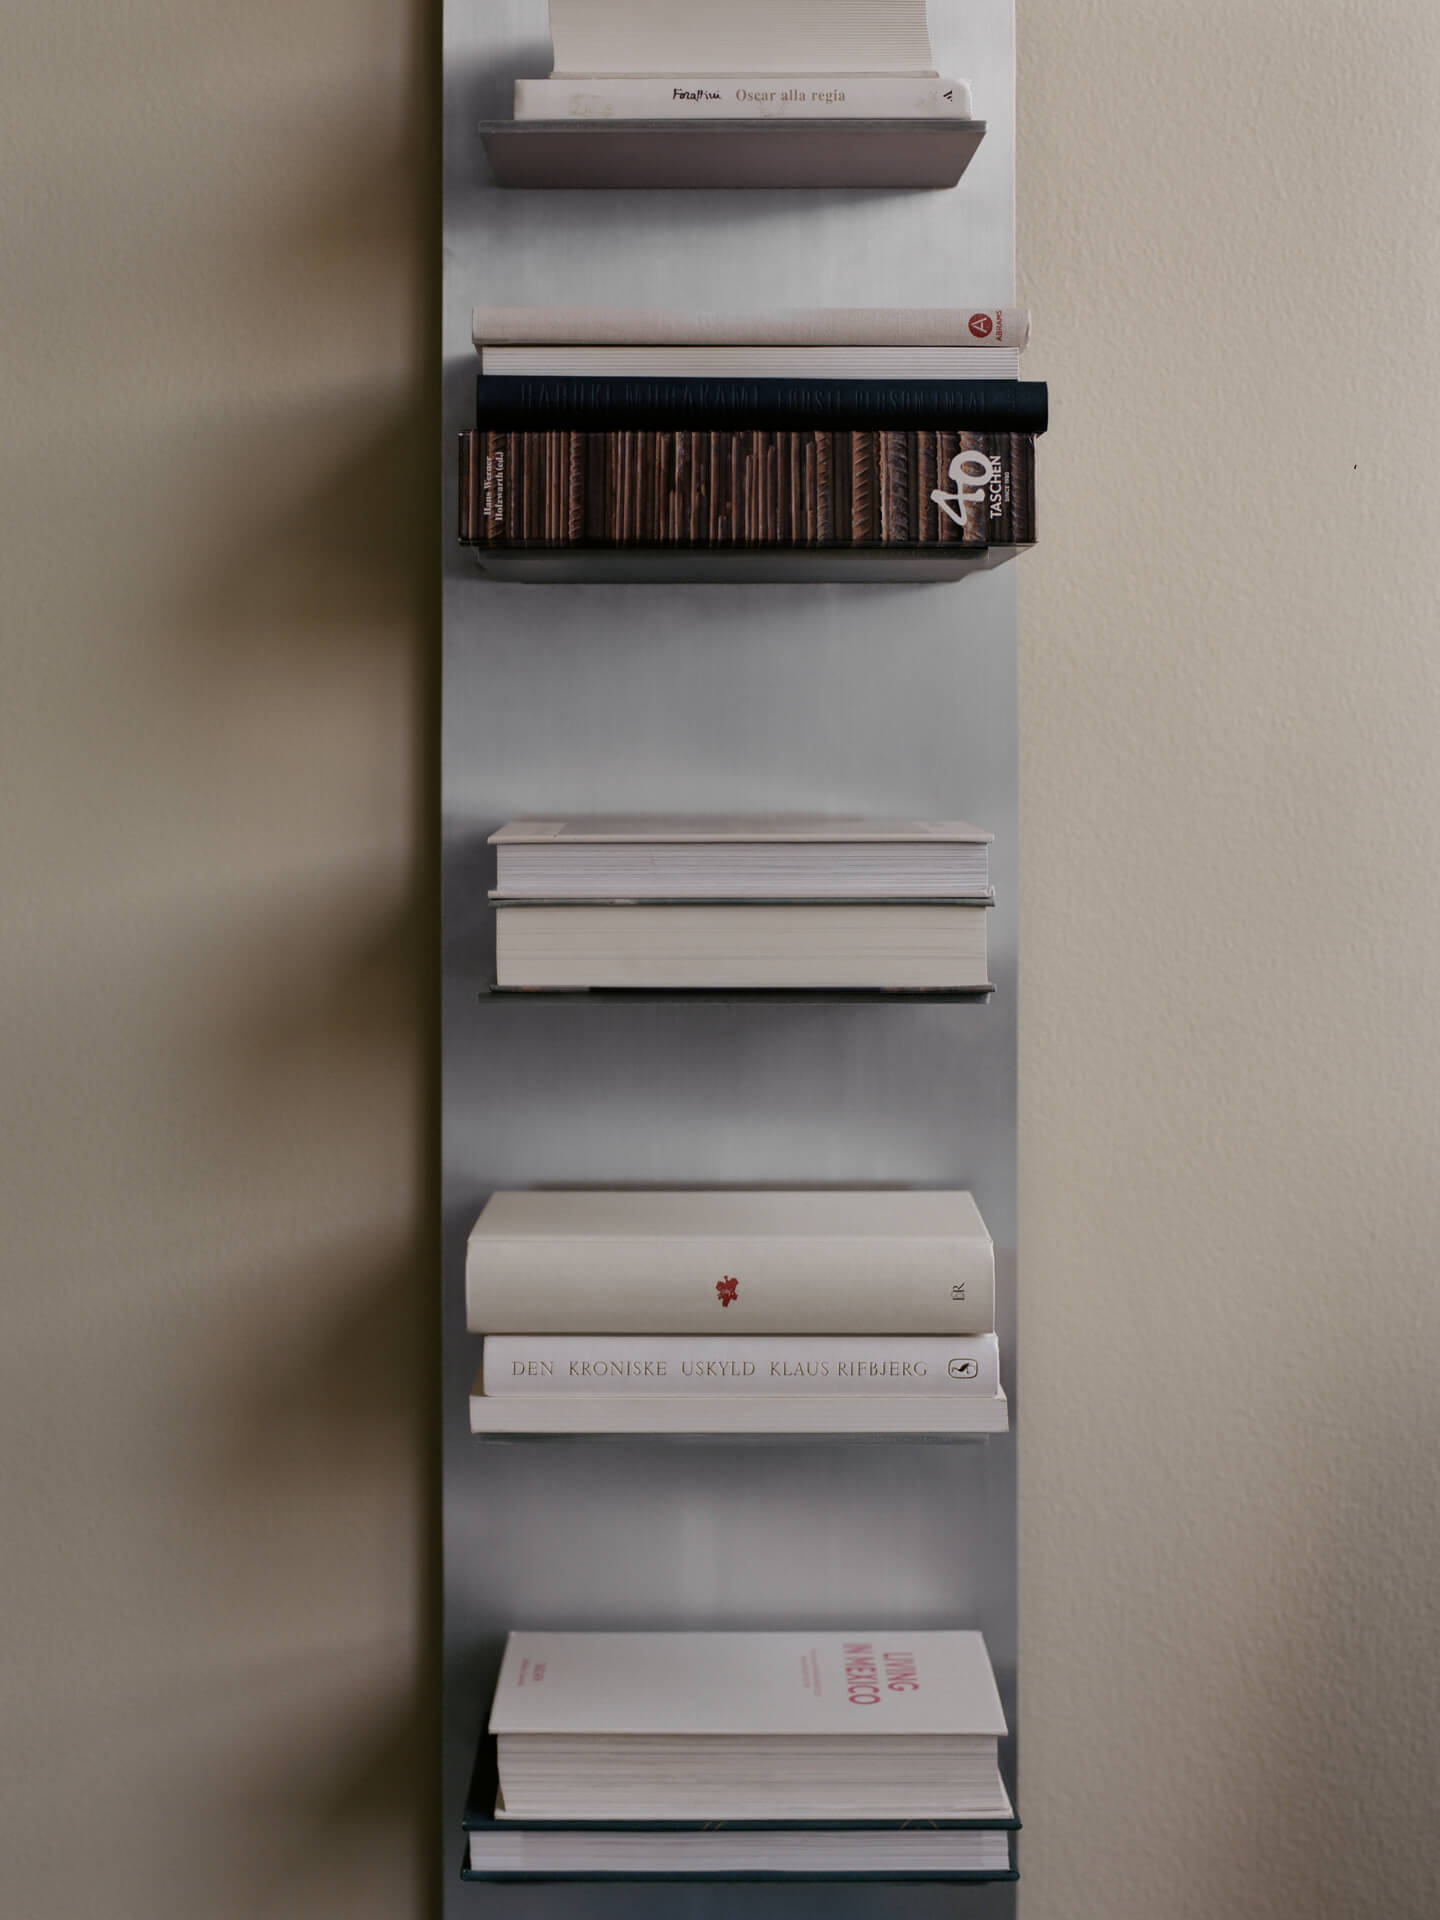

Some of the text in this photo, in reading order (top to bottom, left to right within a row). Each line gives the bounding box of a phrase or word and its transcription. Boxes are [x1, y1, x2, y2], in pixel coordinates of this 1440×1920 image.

[735, 88, 846, 104] Oscar alla regia
[995, 310, 1003, 342] ABRAMS
[483, 455, 492, 516] Hans Werner
[495, 451, 504, 521] Holzwarth (ed.)
[930, 450, 993, 526] 40
[990, 455, 1002, 519] TASCHEN
[511, 1360, 755, 1376] DEN KRONISKE USKYLD
[770, 1360, 928, 1377] KLAUS RIFBJERG
[842, 1642, 881, 1705] IN MEXICO
[883, 1651, 920, 1692] LIVING
